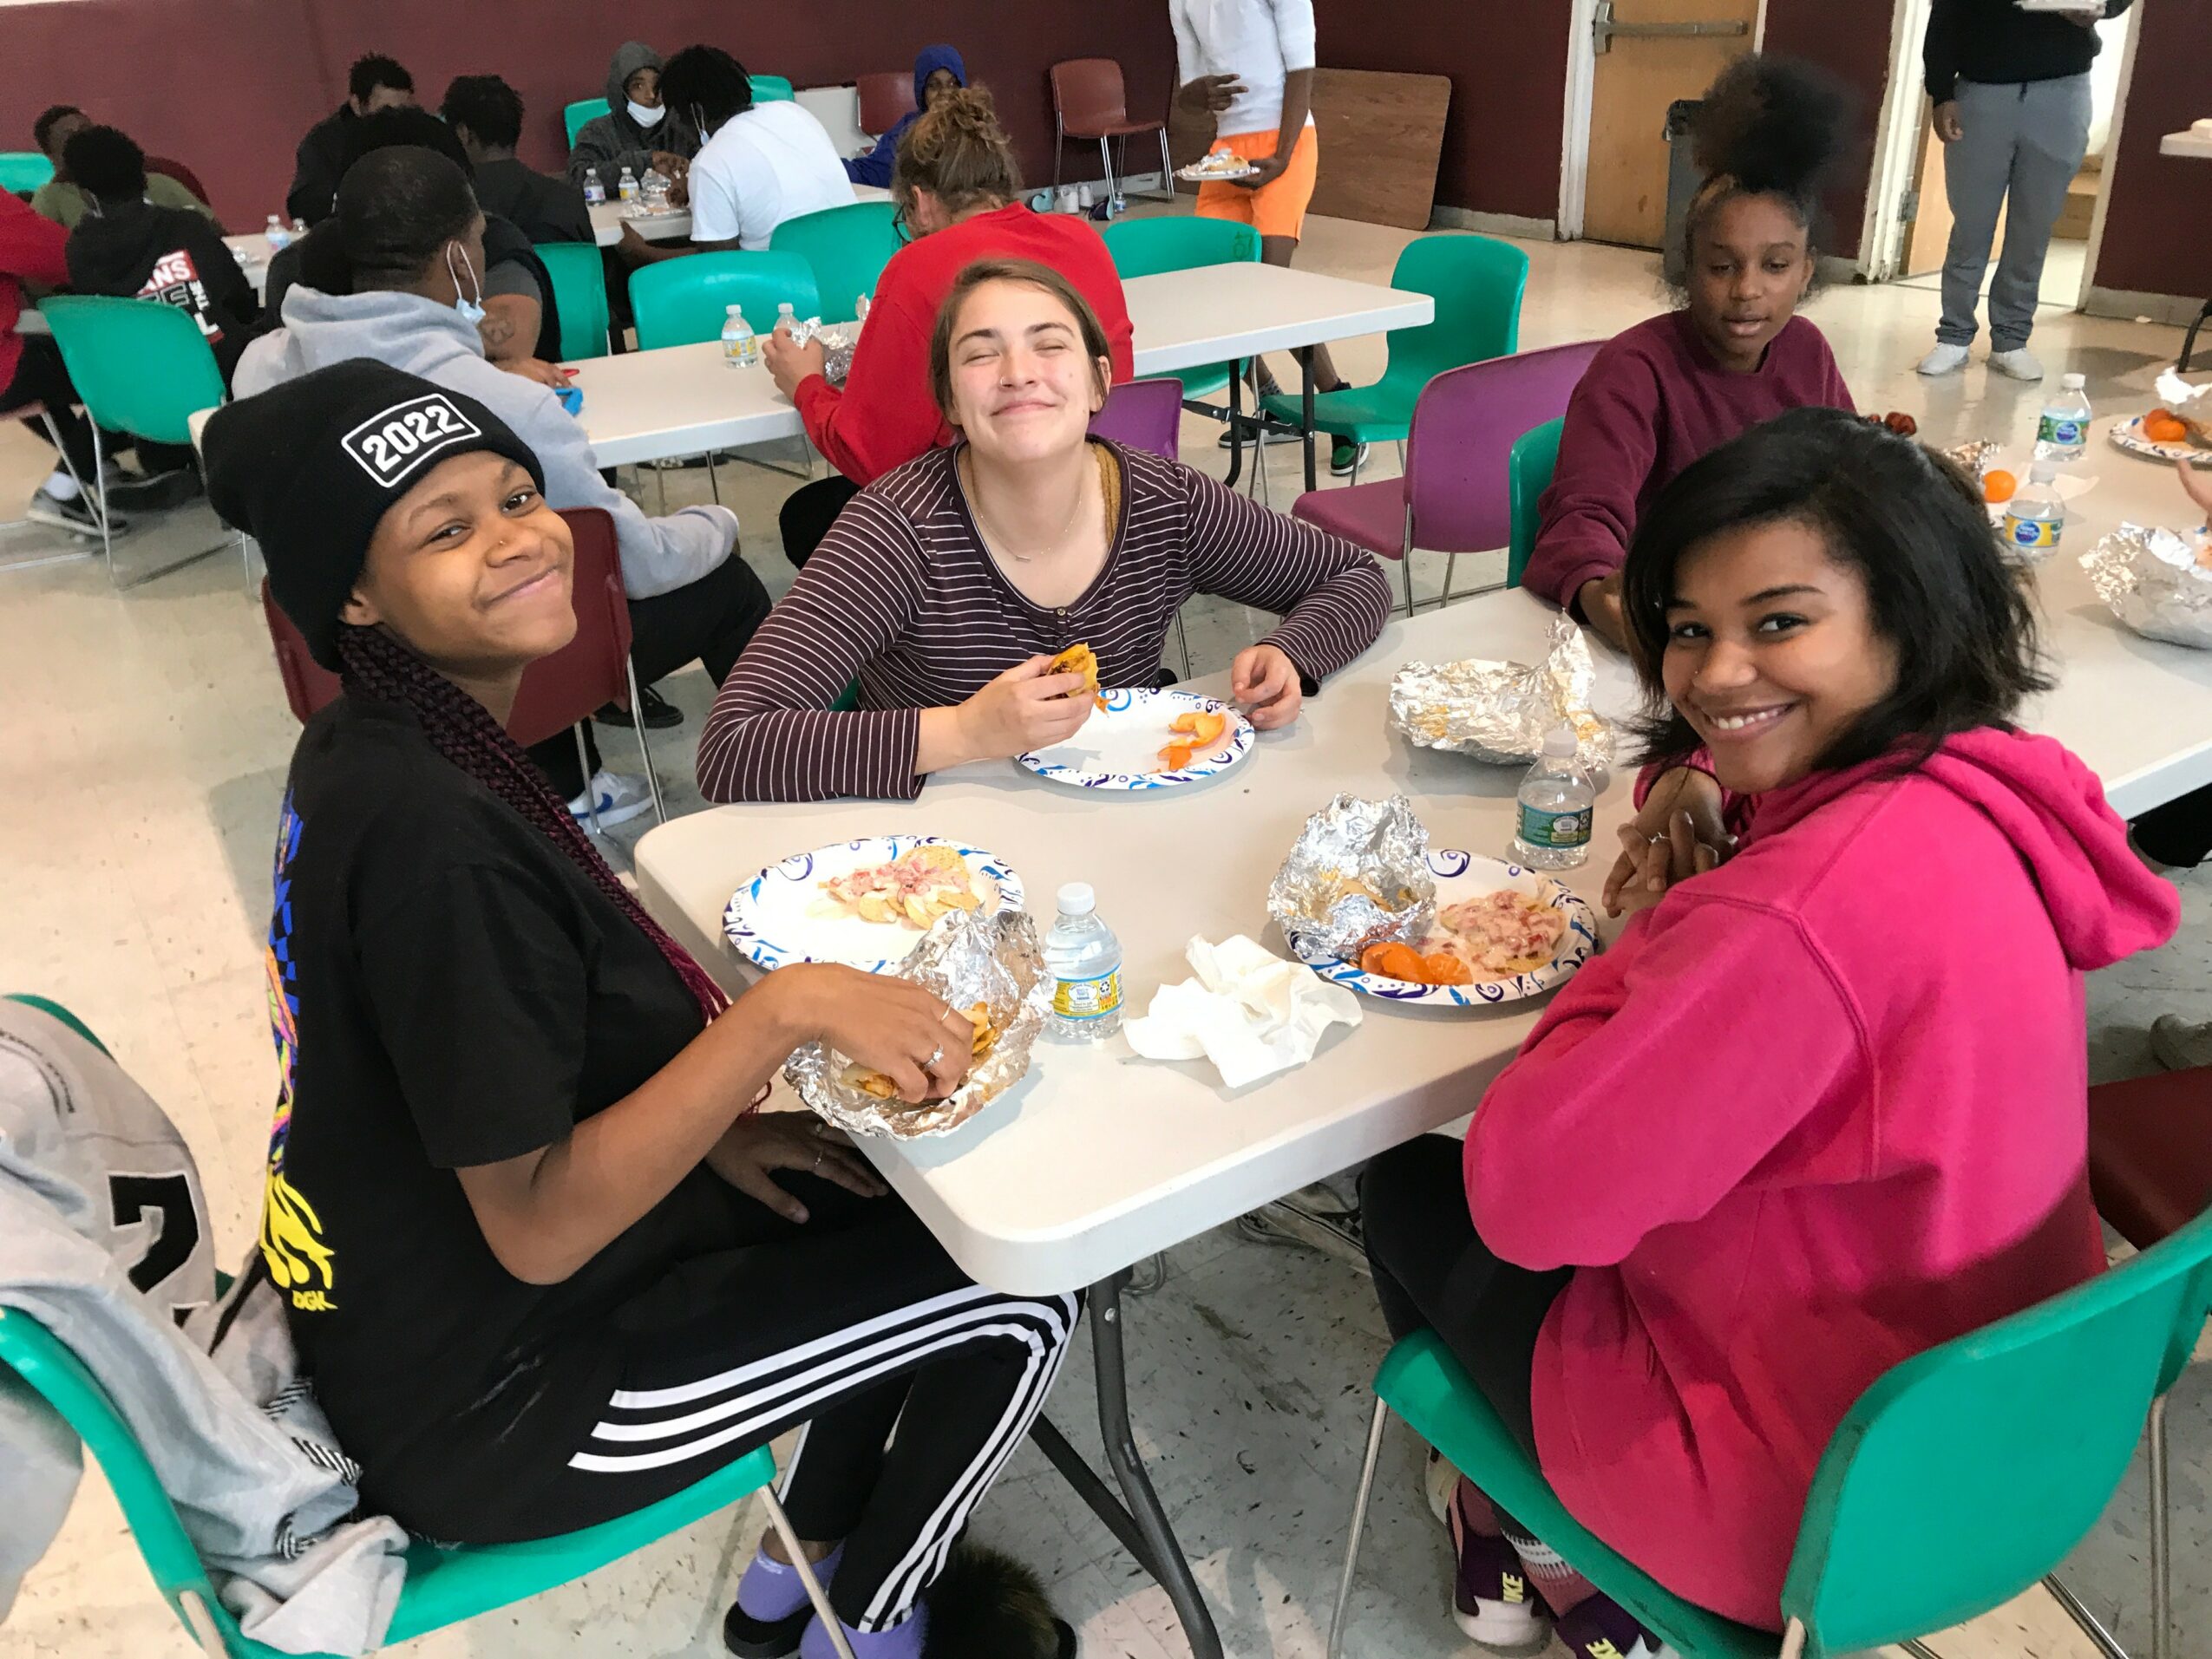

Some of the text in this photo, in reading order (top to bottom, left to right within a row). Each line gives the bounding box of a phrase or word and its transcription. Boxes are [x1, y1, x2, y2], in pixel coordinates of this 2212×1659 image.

[138, 259, 191, 292] ANS
[361, 404, 466, 473] 2022
[292, 1289, 339, 1312] DGK
[1502, 1571, 1524, 1603] IKE
